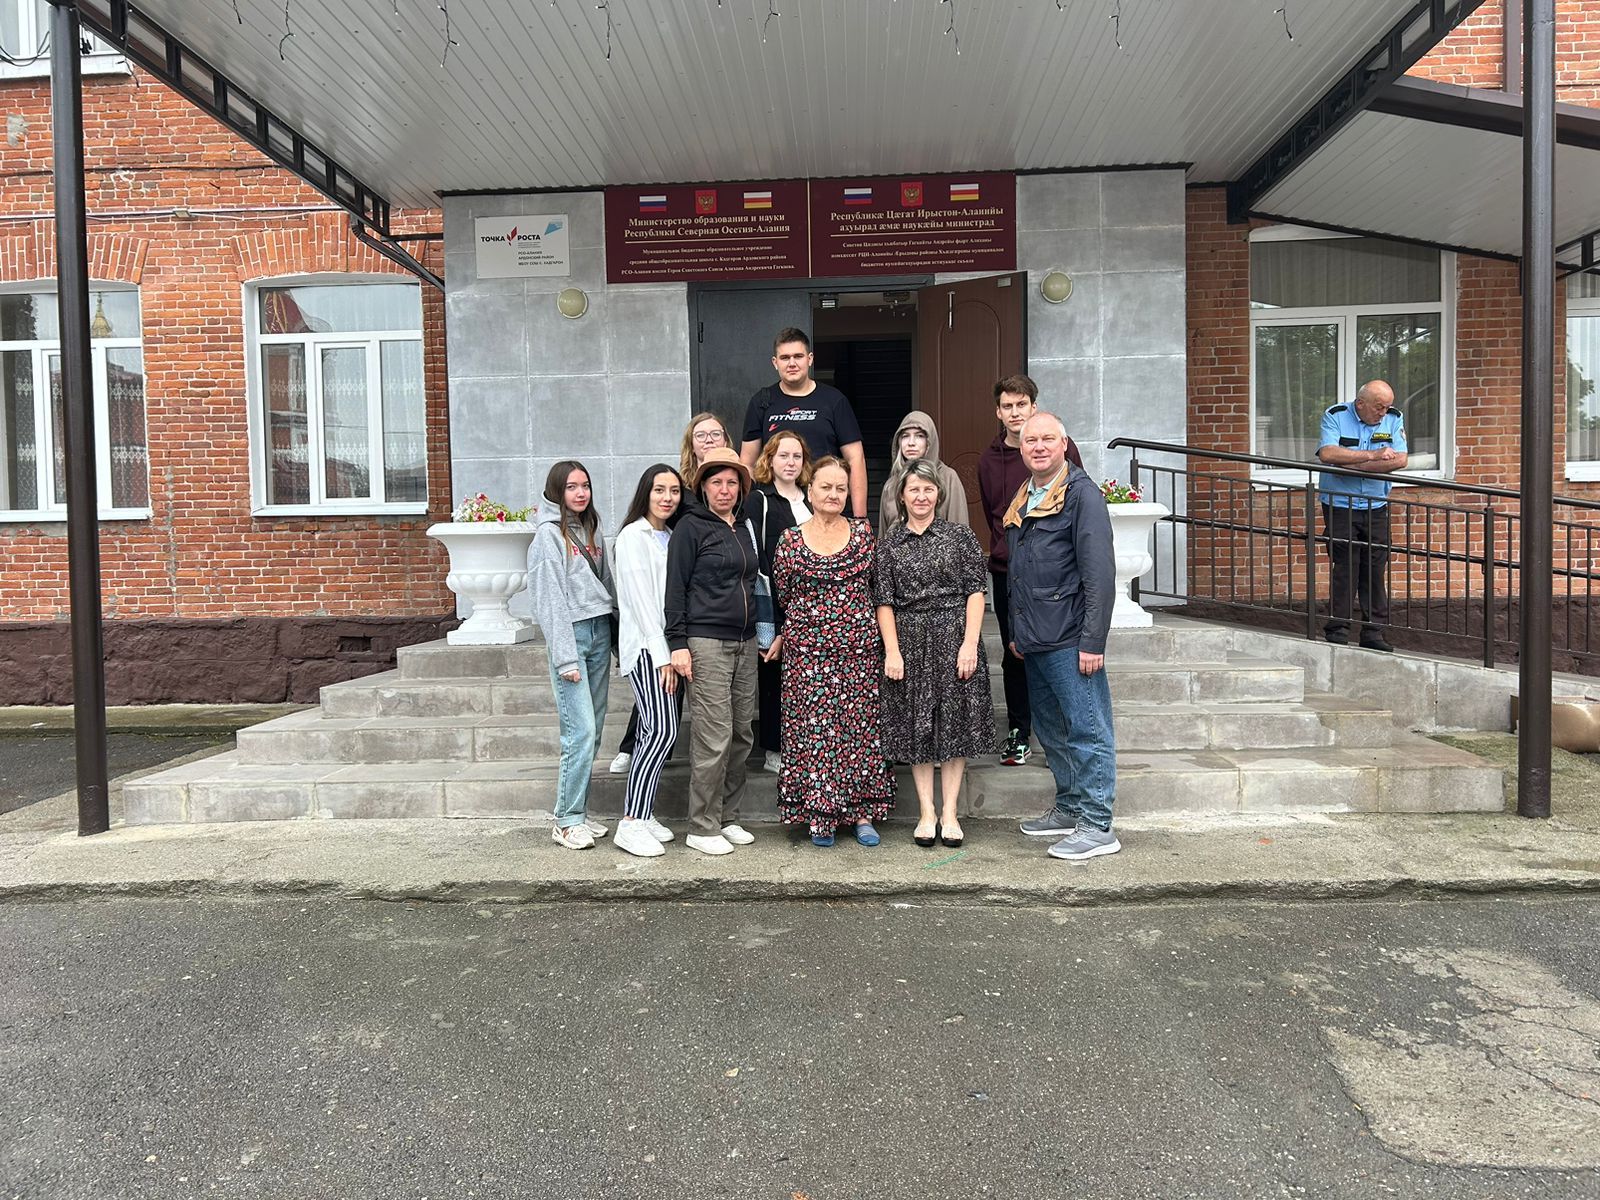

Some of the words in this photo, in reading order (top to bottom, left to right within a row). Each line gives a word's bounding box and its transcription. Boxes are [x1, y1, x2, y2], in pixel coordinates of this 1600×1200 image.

[629, 217, 692, 227] Министерство
[694, 215, 749, 226] образования
[759, 214, 785, 223] науки
[946, 219, 995, 228] министрад
[624, 228, 676, 239] Республики
[677, 227, 720, 237] Северная
[721, 225, 790, 235] Осетия-Алания
[768, 414, 817, 422] FITNESS
